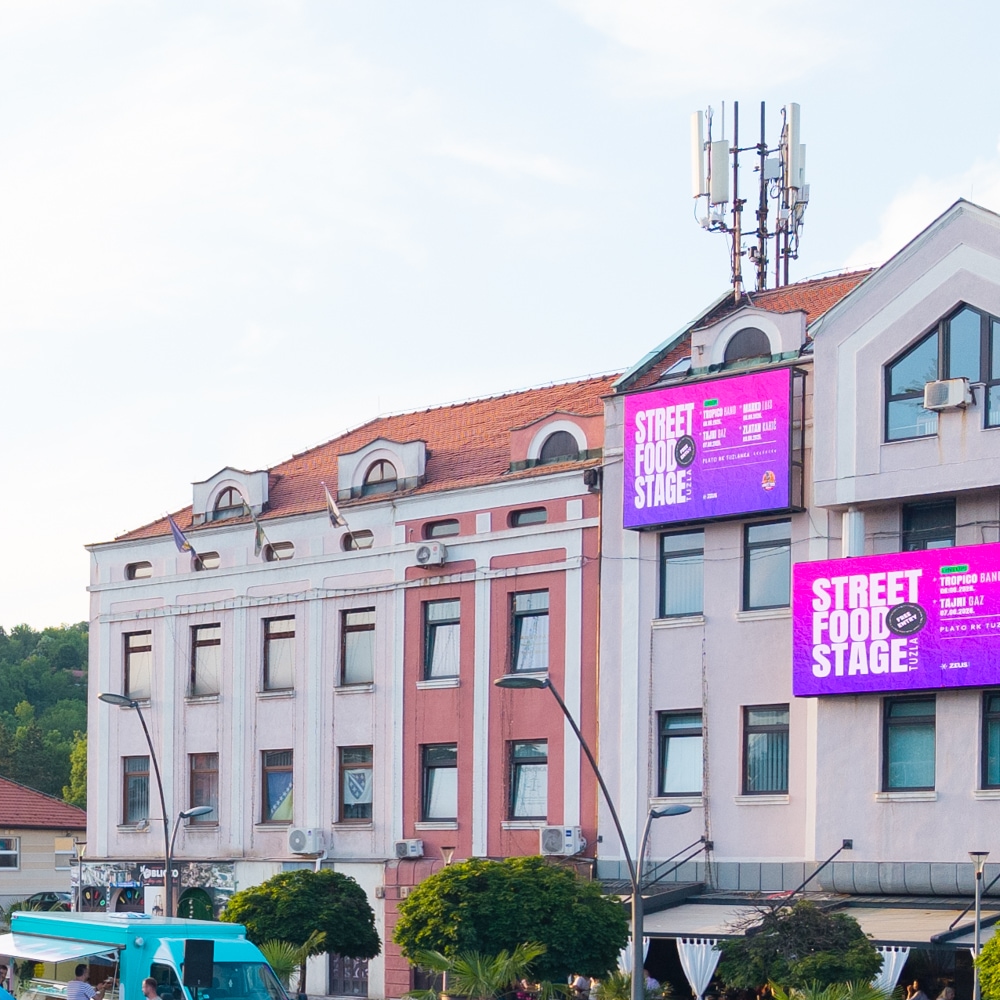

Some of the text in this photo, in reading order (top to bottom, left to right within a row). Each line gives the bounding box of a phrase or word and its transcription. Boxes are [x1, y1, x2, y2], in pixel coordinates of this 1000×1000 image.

[635, 403, 695, 444] STREET
[635, 439, 678, 477] FOOD
[634, 470, 688, 509] STAGE
[812, 569, 922, 611] STREET
[940, 574, 978, 586] TROPICO
[896, 611, 911, 622] FREE
[940, 595, 984, 608] TAJNI GAZ
[813, 606, 890, 645] FOOD
[897, 614, 917, 628] ENTRY
[940, 625, 967, 633] PLATO
[812, 638, 908, 678] STAGE
[909, 637, 918, 671] TUZLA
